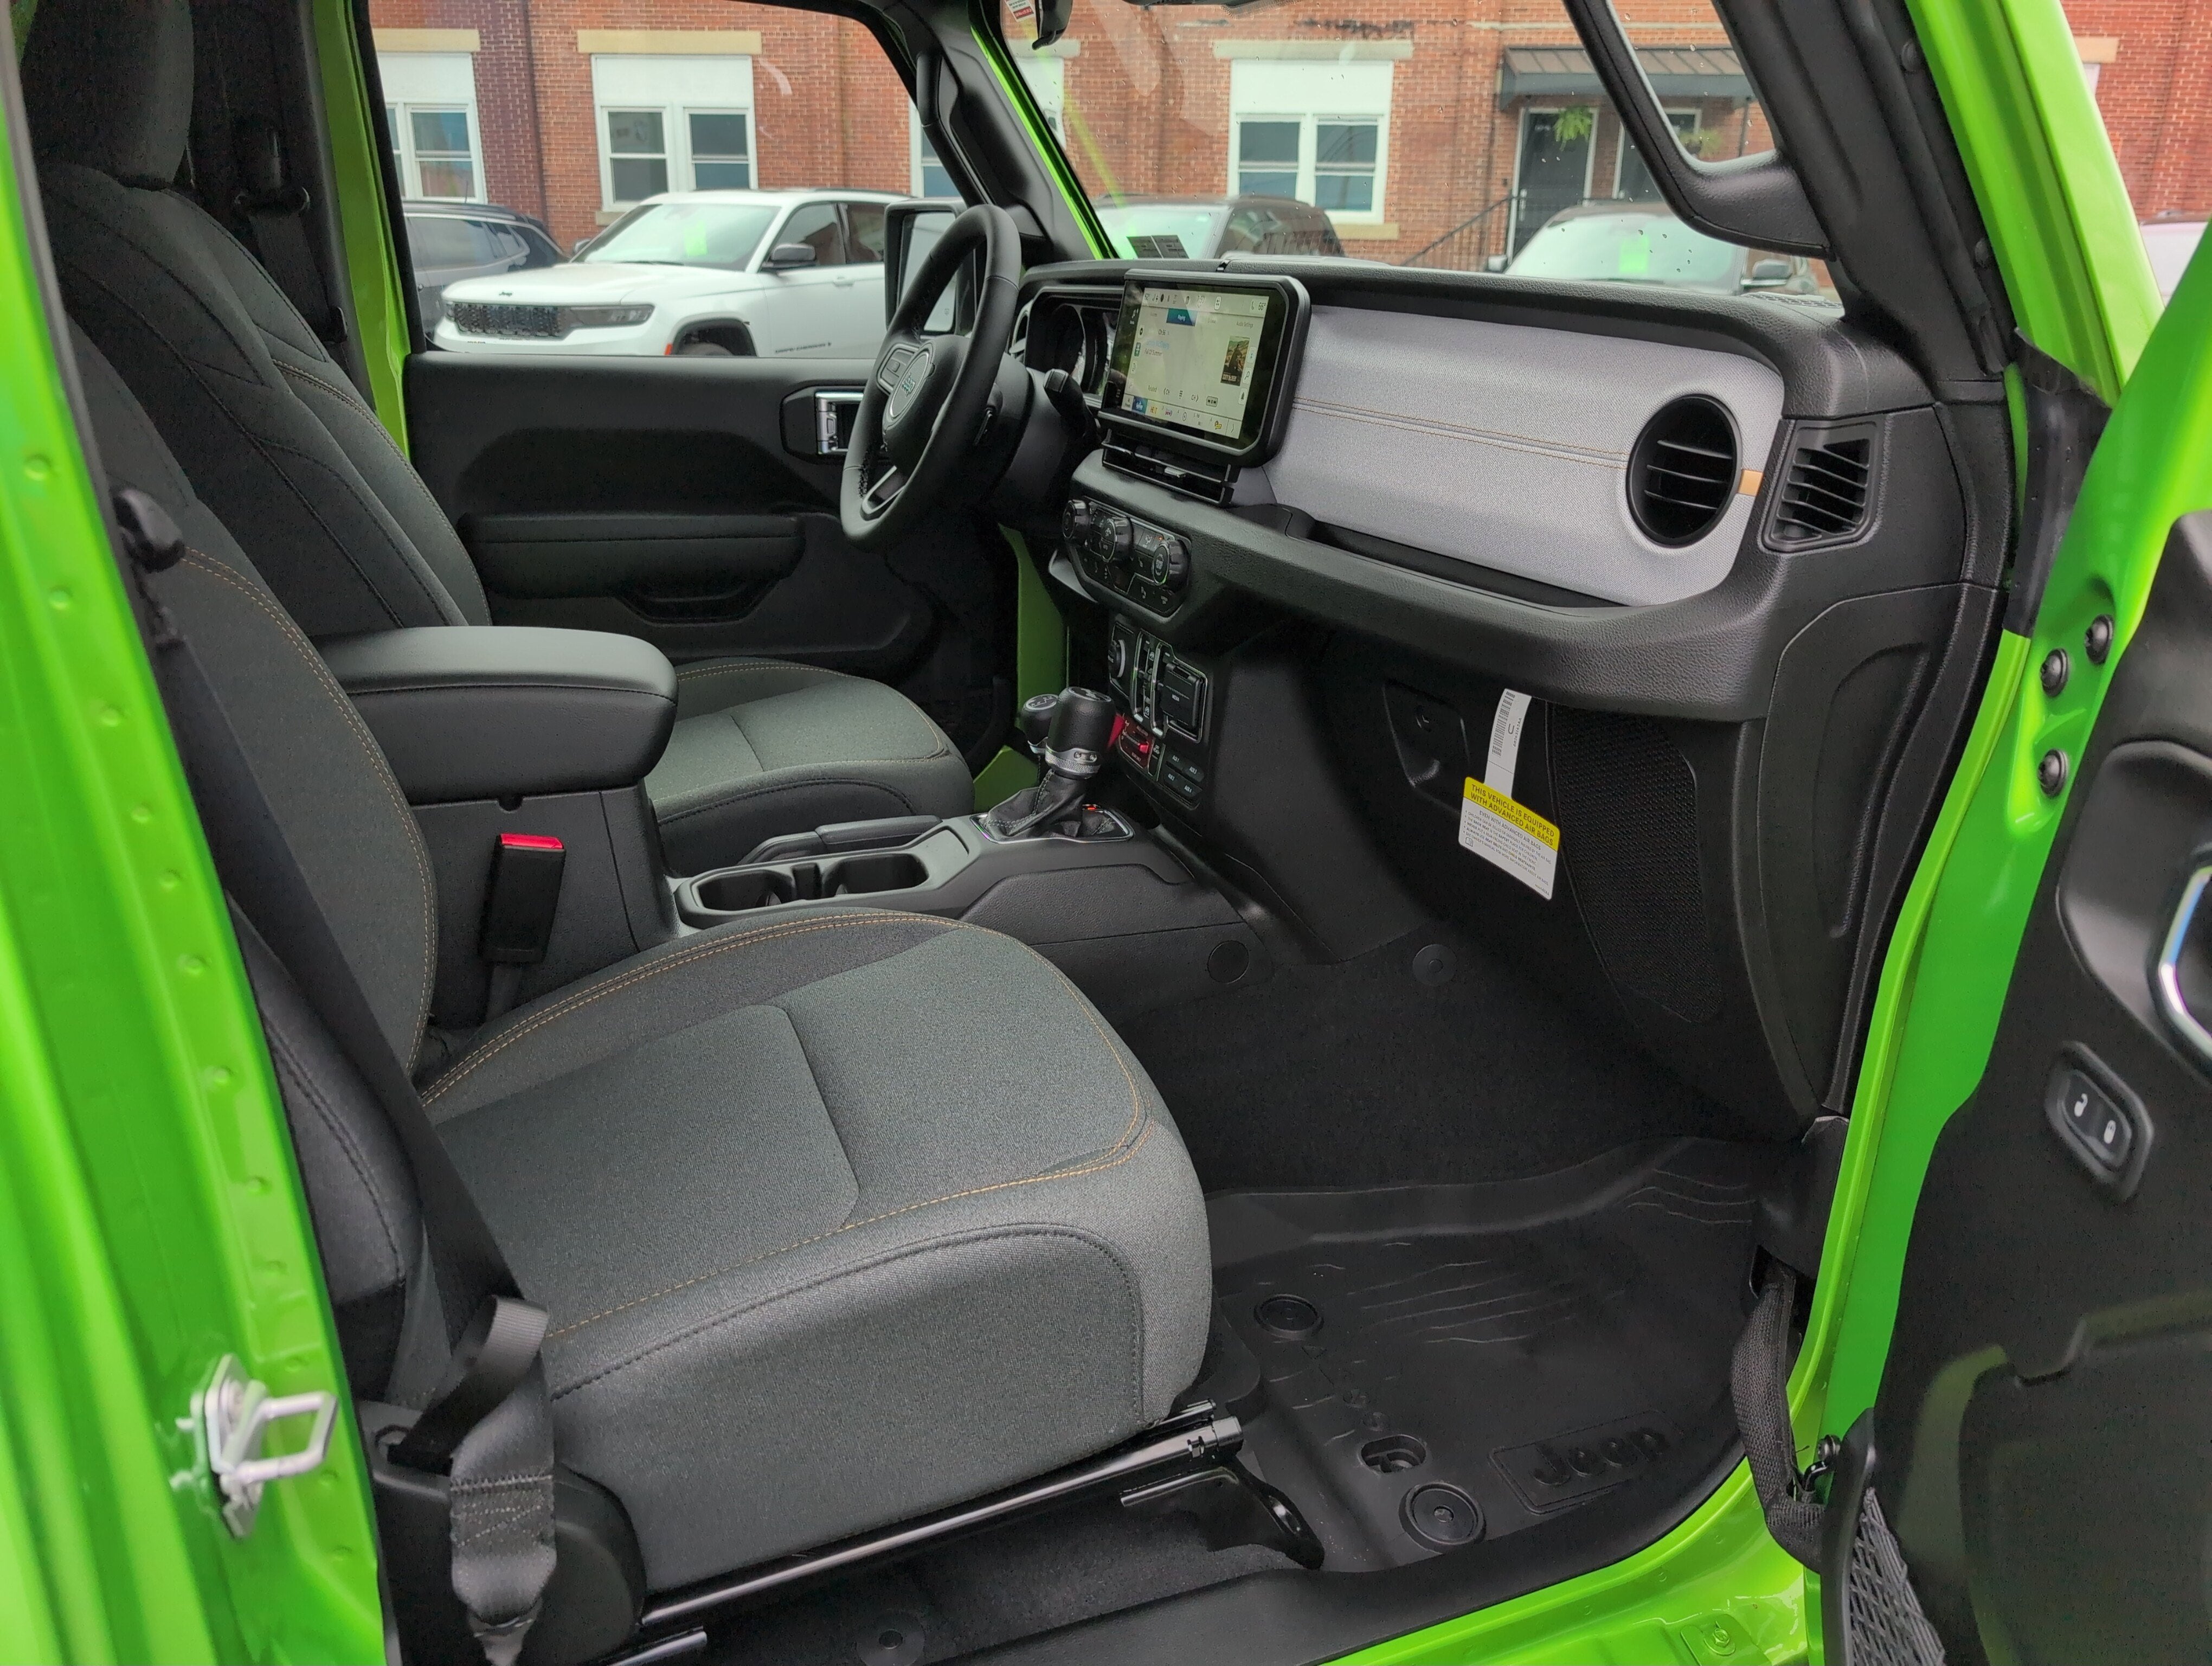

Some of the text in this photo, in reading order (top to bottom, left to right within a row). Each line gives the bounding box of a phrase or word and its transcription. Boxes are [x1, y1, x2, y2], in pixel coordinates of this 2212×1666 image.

[1471, 792, 1553, 845] WITH ADVANCED AIR BAGS
[1472, 784, 1554, 837] THIS VEHICLE IS EQUIPPED
[1480, 810, 1490, 819] EVEN
[1491, 817, 1501, 825] WITH
[1502, 823, 1523, 838] ADVANCED
[1531, 840, 1541, 850] BAGS
